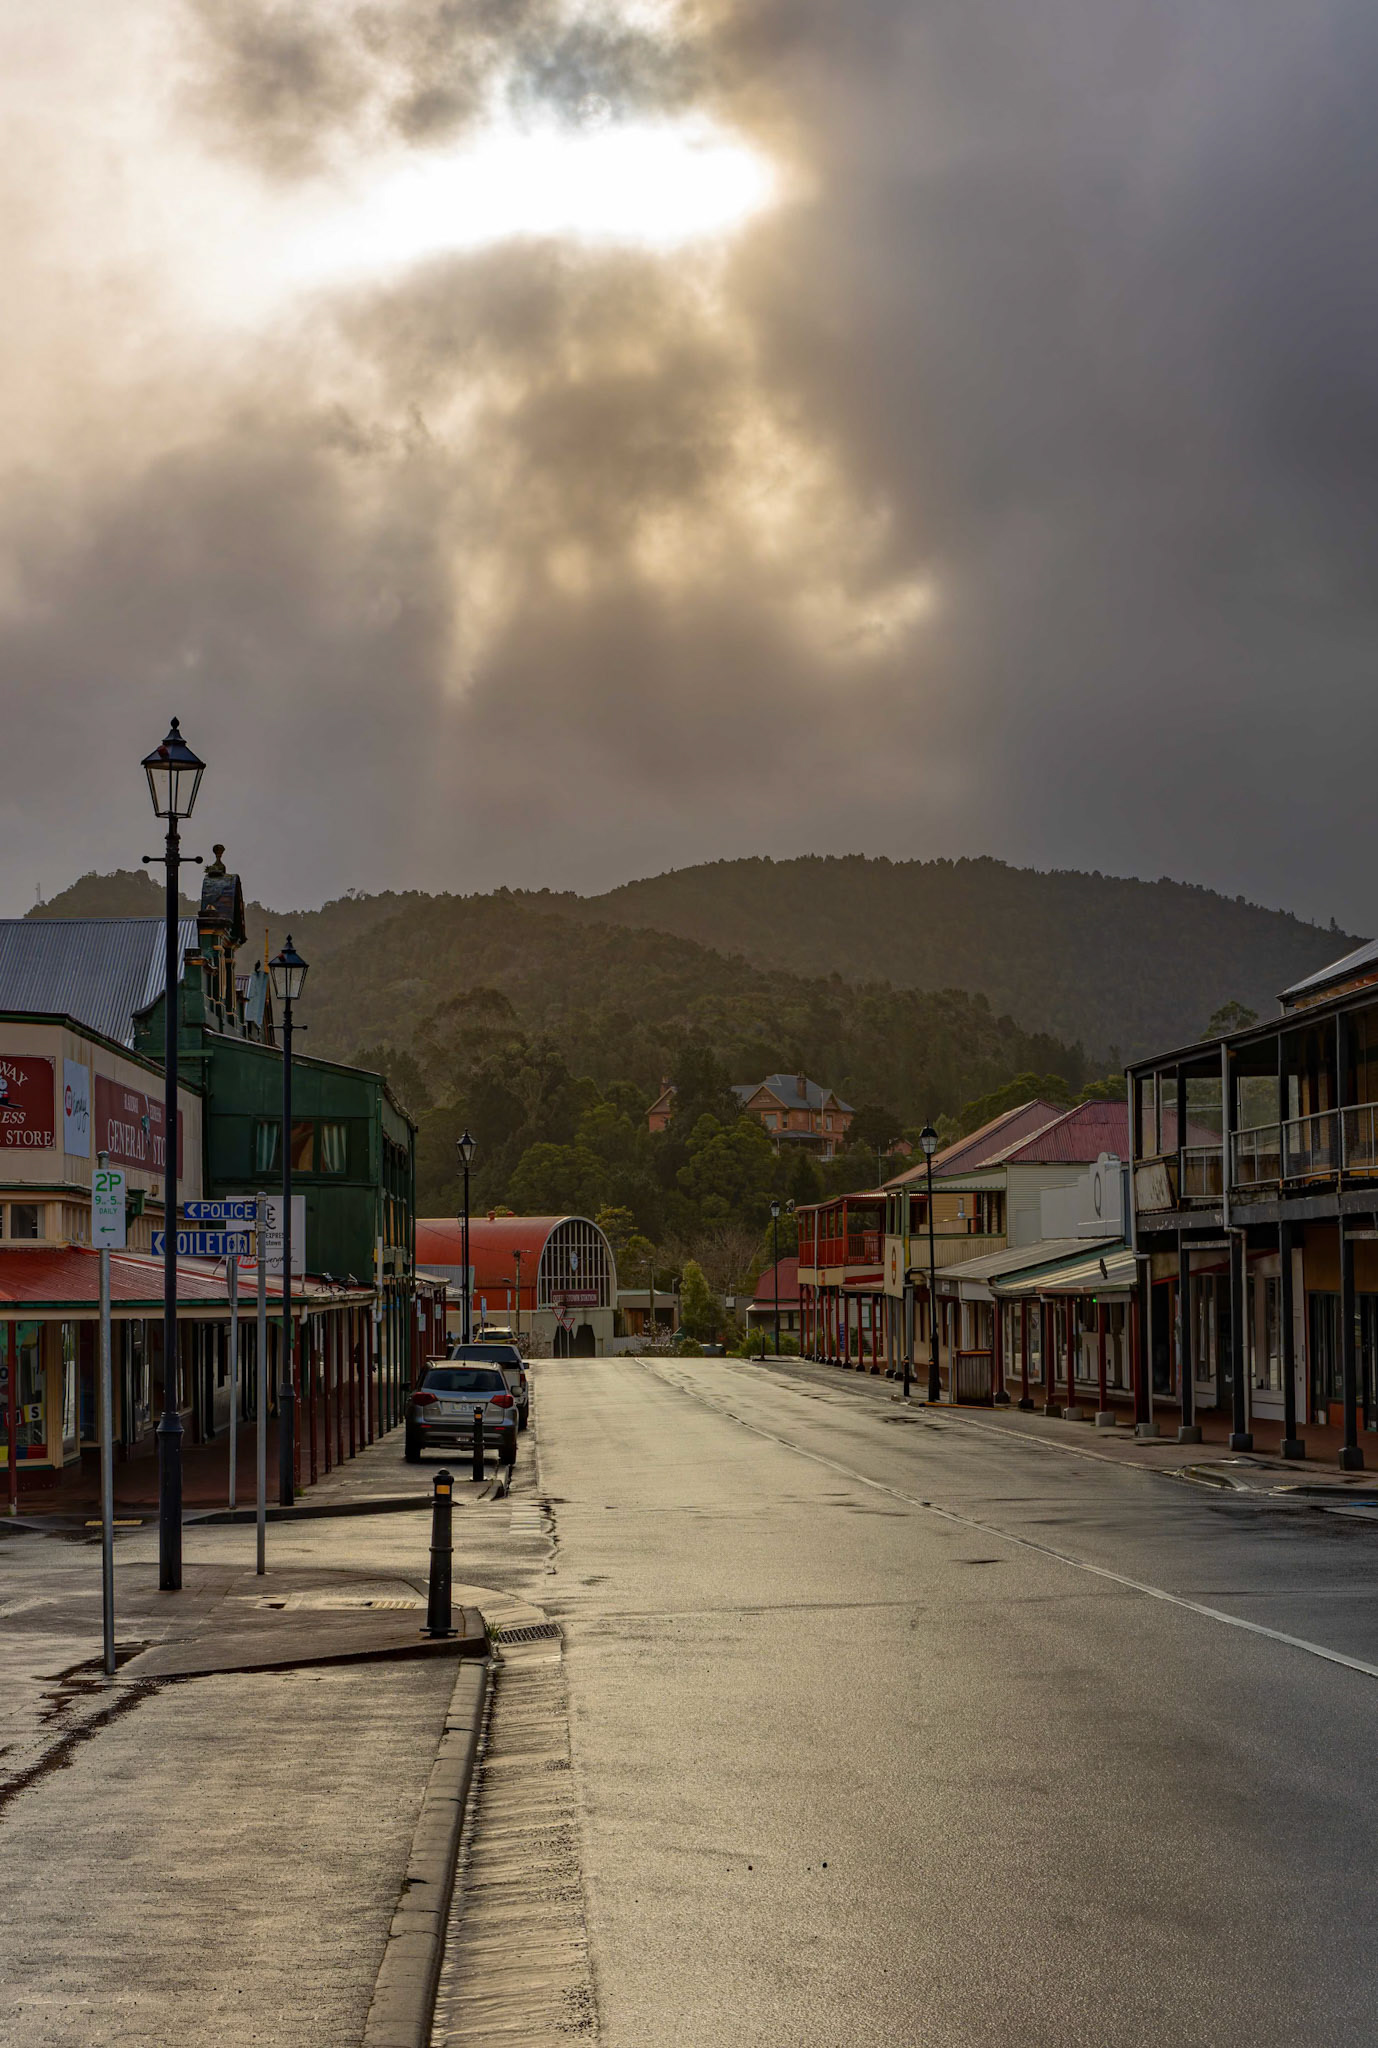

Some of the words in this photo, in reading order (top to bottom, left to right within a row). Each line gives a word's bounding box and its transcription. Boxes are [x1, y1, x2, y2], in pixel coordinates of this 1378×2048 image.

[6, 1129, 52, 1145] STORE
[107, 1118, 146, 1161] GENERAL
[153, 1134, 166, 1167] STO
[95, 1173, 122, 1192] 2P
[99, 1207, 118, 1215] DAILY
[200, 1203, 254, 1218] POLICE
[176, 1232, 226, 1254] OILET
